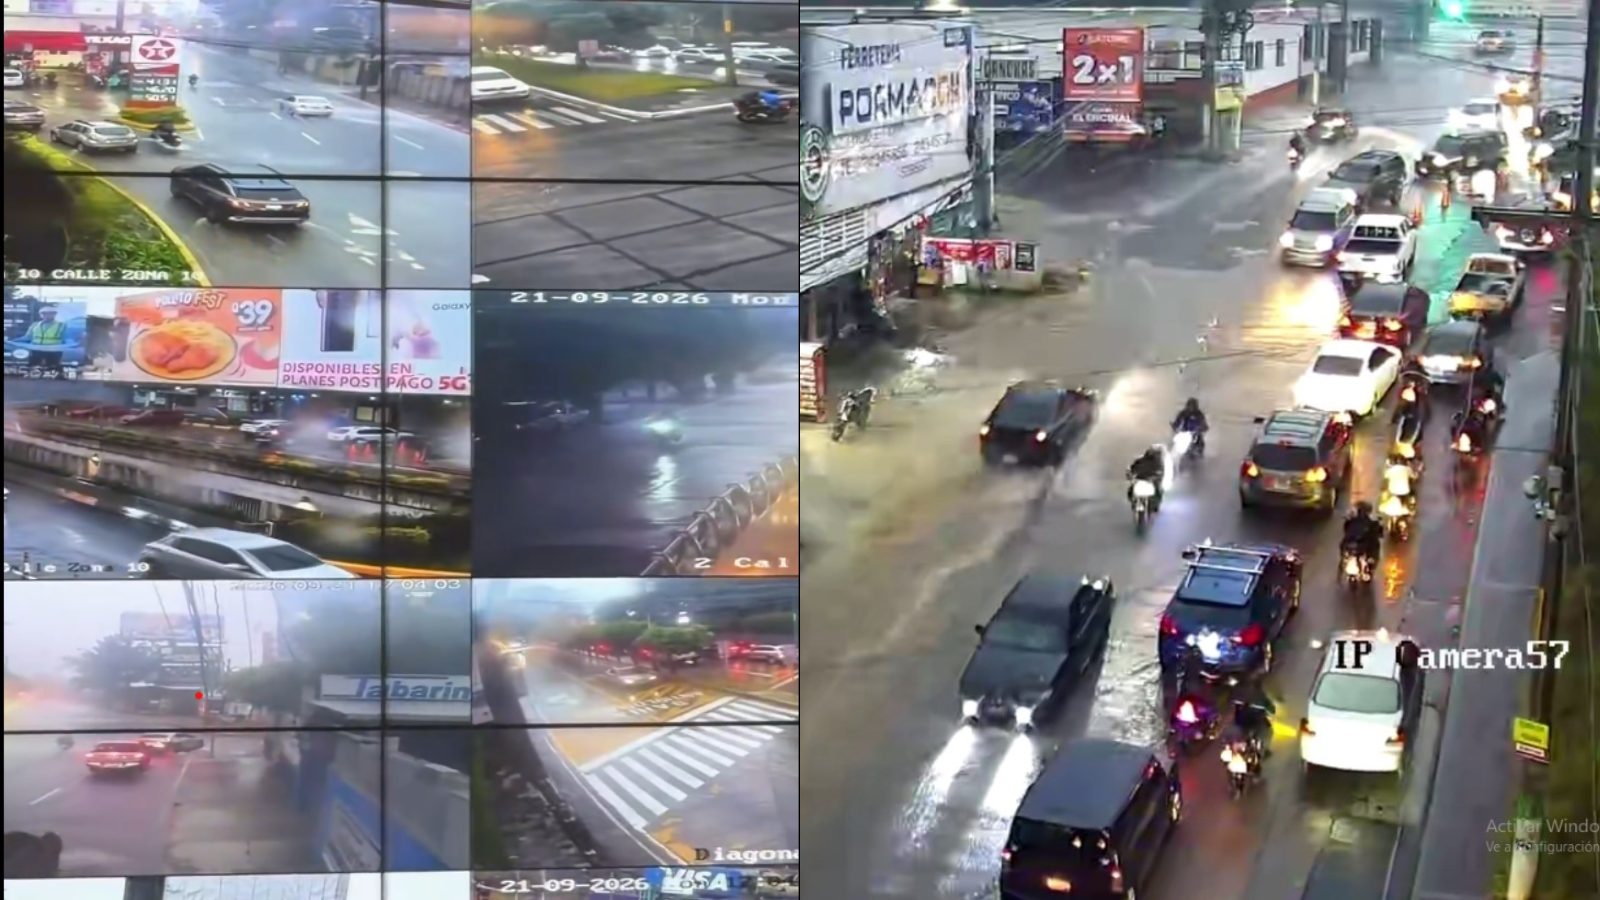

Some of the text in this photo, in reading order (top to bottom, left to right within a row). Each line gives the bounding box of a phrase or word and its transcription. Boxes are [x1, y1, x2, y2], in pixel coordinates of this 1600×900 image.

[1072, 54, 1134, 84] 2x1
[19, 269, 40, 279] 10
[52, 269, 110, 280] CALLE
[194, 291, 226, 310] FEST
[510, 292, 791, 305] 21-09-2026 Mon
[283, 363, 412, 375] DISPONIBLES EN
[283, 374, 335, 387] PLANES
[438, 377, 467, 391] 5G
[127, 562, 150, 573] 10
[694, 557, 789, 569] 2 Cal
[500, 877, 650, 893] 21-09-2026
